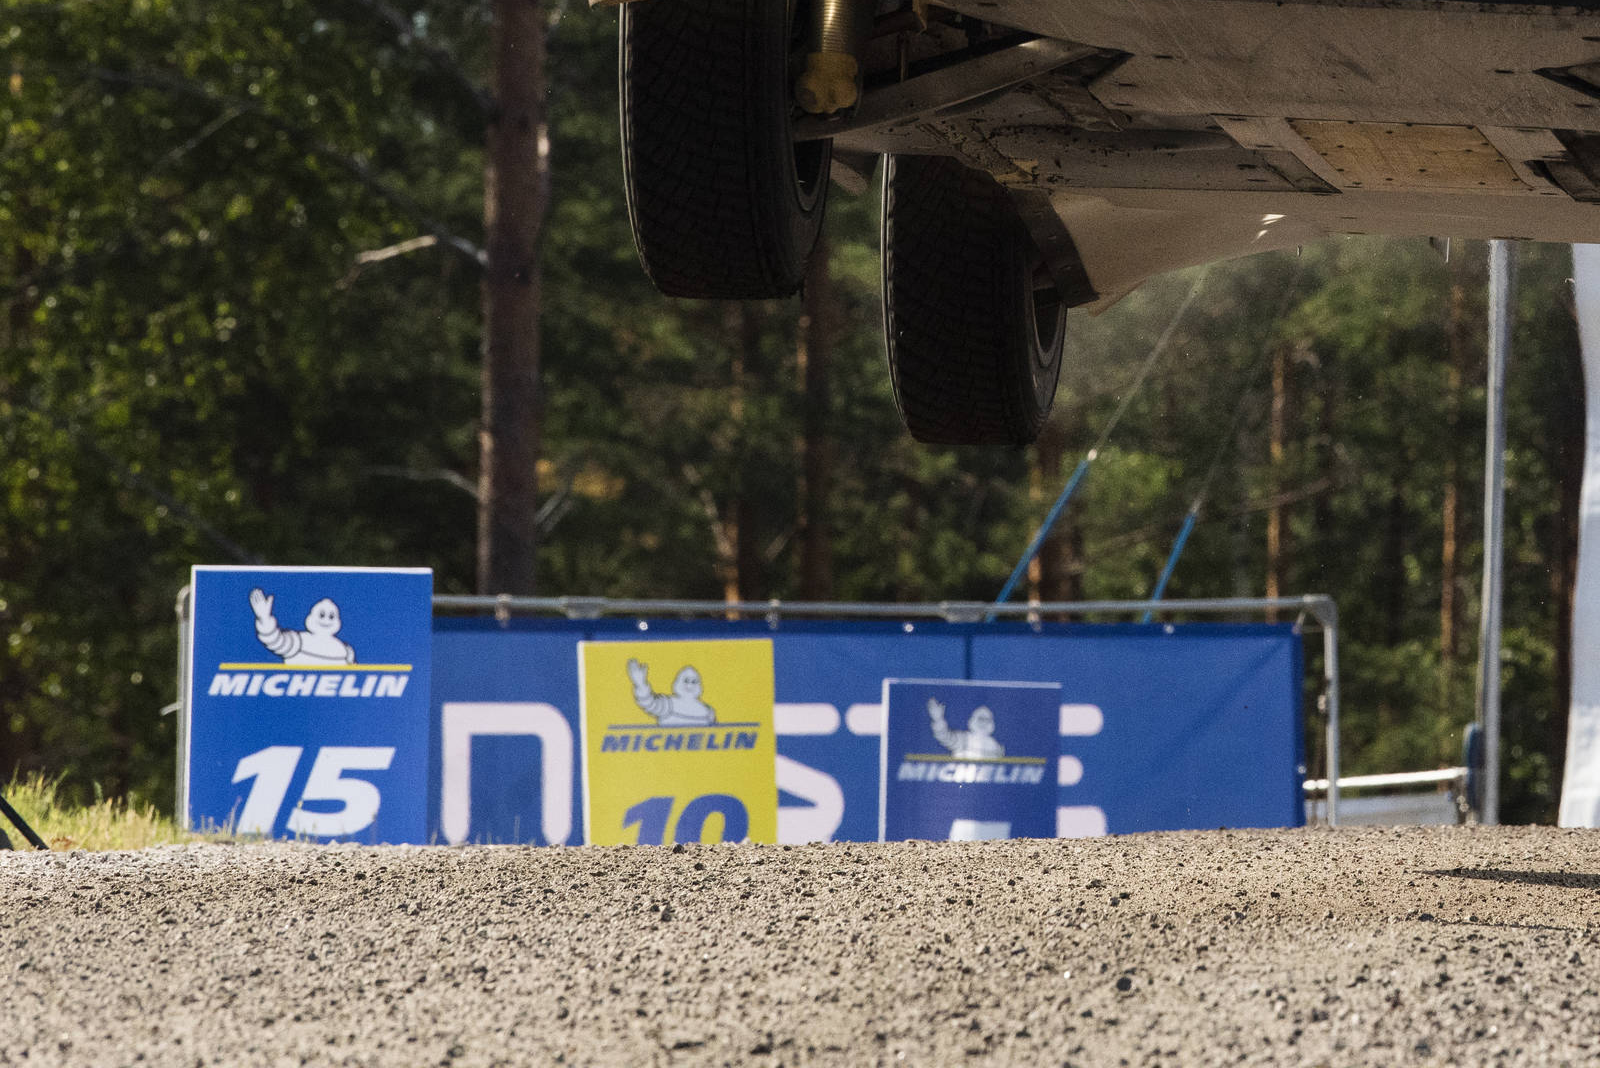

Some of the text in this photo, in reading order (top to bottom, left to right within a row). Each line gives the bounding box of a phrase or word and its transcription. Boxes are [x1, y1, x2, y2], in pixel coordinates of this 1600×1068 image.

[208, 673, 409, 698] MICHELIN
[601, 732, 758, 753] MICHELIN
[898, 761, 1044, 784] MICHELIN
[231, 745, 396, 837] 15
